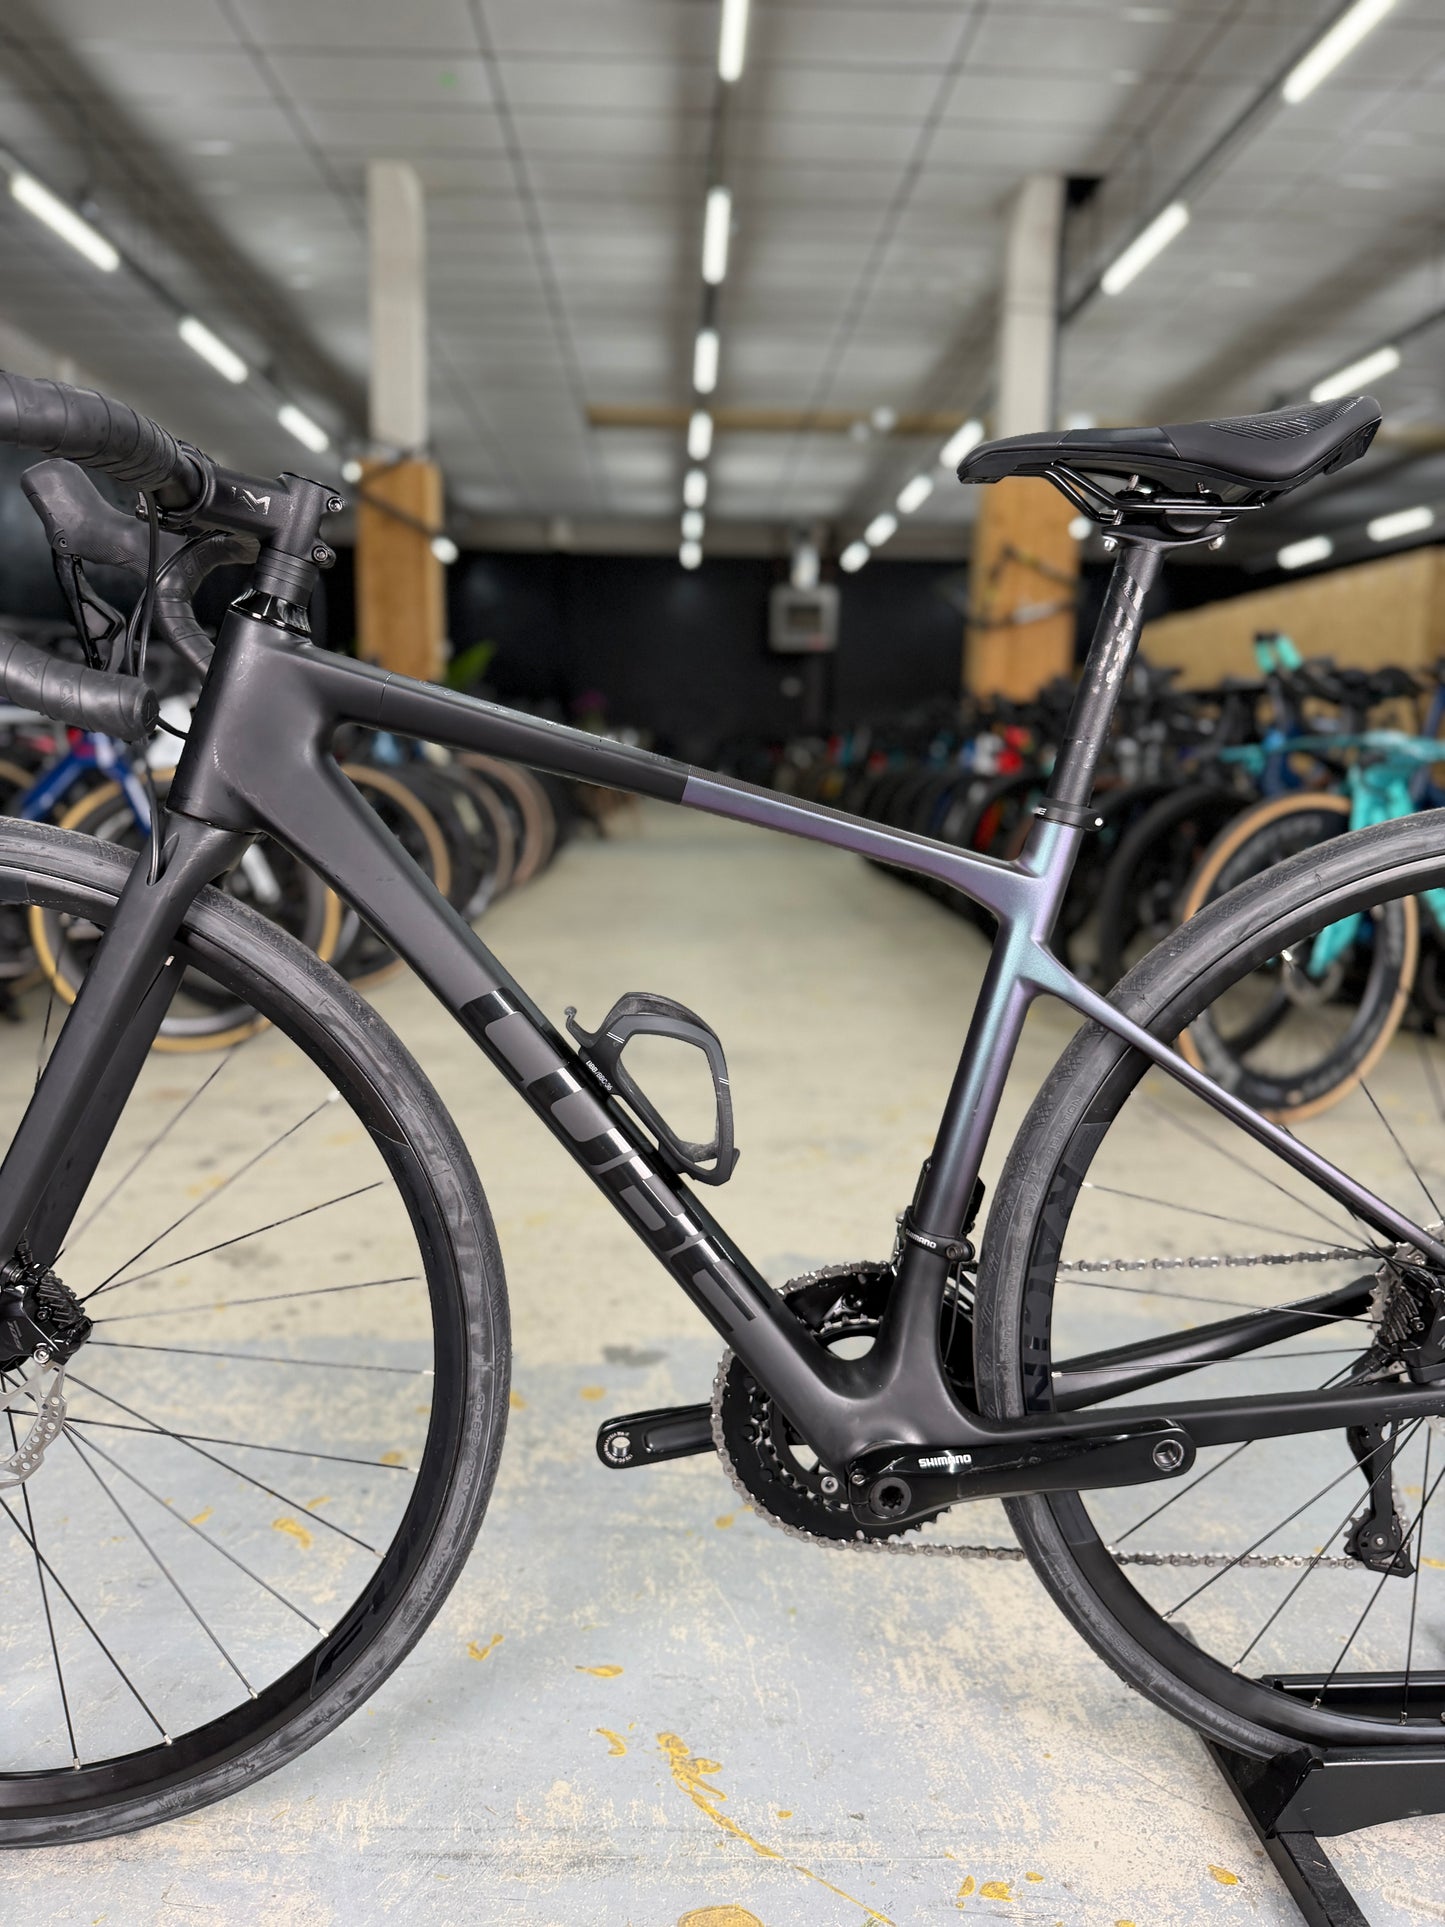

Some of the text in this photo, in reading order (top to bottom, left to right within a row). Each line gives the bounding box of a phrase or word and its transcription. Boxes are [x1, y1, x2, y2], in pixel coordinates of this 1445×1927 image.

[459, 986, 771, 1334] CUBE
[1022, 1161, 1084, 1414] RACIN
[918, 1454, 972, 1469] SHIMANO
